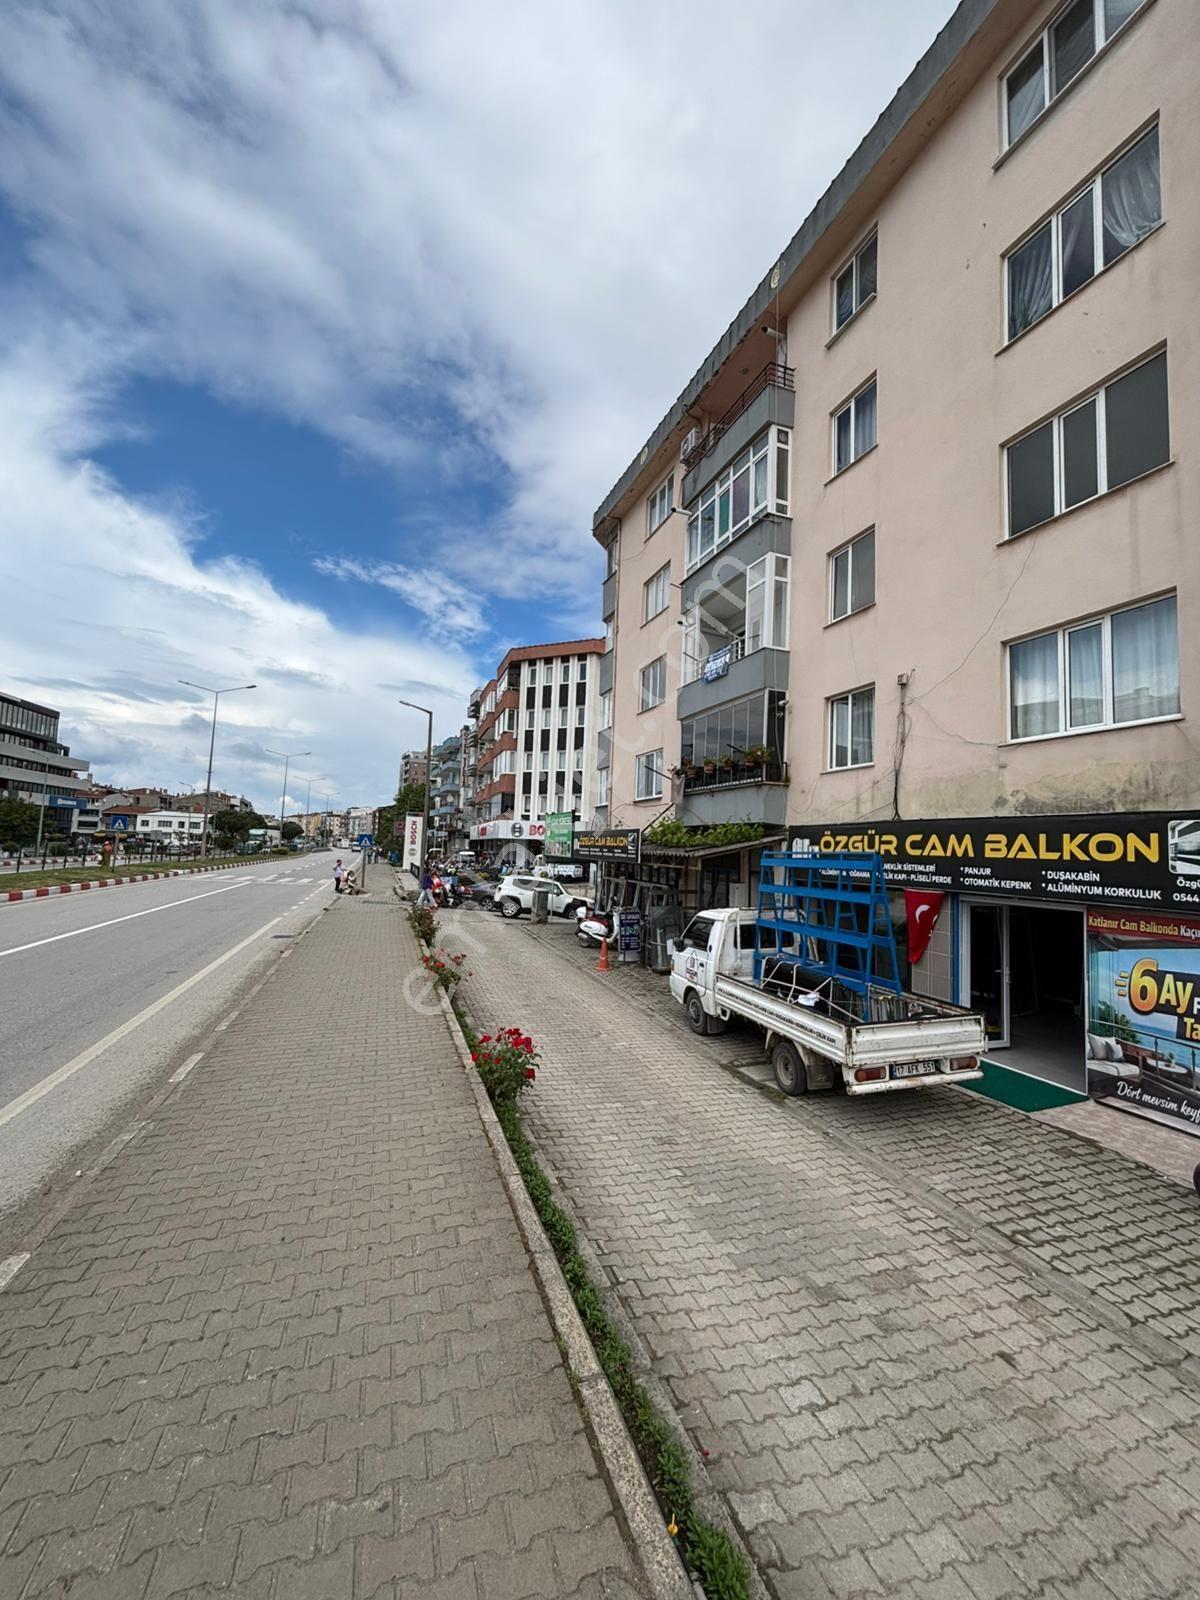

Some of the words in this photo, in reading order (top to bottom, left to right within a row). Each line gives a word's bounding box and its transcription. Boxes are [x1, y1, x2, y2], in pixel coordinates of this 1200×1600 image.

[528, 824, 545, 836] BO
[819, 829, 898, 856] ÖZGÜR
[905, 833, 975, 858] CAM
[984, 832, 1159, 864] BALKON
[903, 862, 936, 872] SİSTEMLERİ
[965, 866, 991, 876] PANJUR
[910, 873, 931, 882] PLİSELİ
[931, 875, 952, 884] PERDE
[964, 876, 1000, 889] OTOMATİK
[1000, 880, 1031, 890] KEPENK
[1047, 870, 1099, 882] DUŞAKABİN
[1176, 876, 1200, 890] Özgü
[1046, 882, 1103, 895] ALÜMİNYUM
[1104, 887, 1162, 900] KORKULUK
[1172, 892, 1200, 903] 0544
[1088, 915, 1119, 929] Katlanır
[1120, 919, 1138, 931] Cam
[1140, 922, 1179, 936] Balkonda
[1129, 957, 1159, 1013] 6
[1158, 973, 1194, 1015] Ay
[1183, 1017, 1200, 1040] Ta
[896, 1066, 904, 1075] 17
[907, 1064, 920, 1074] AFK
[1142, 1094, 1179, 1112] mevsim
[1180, 1099, 1200, 1124] keyf
